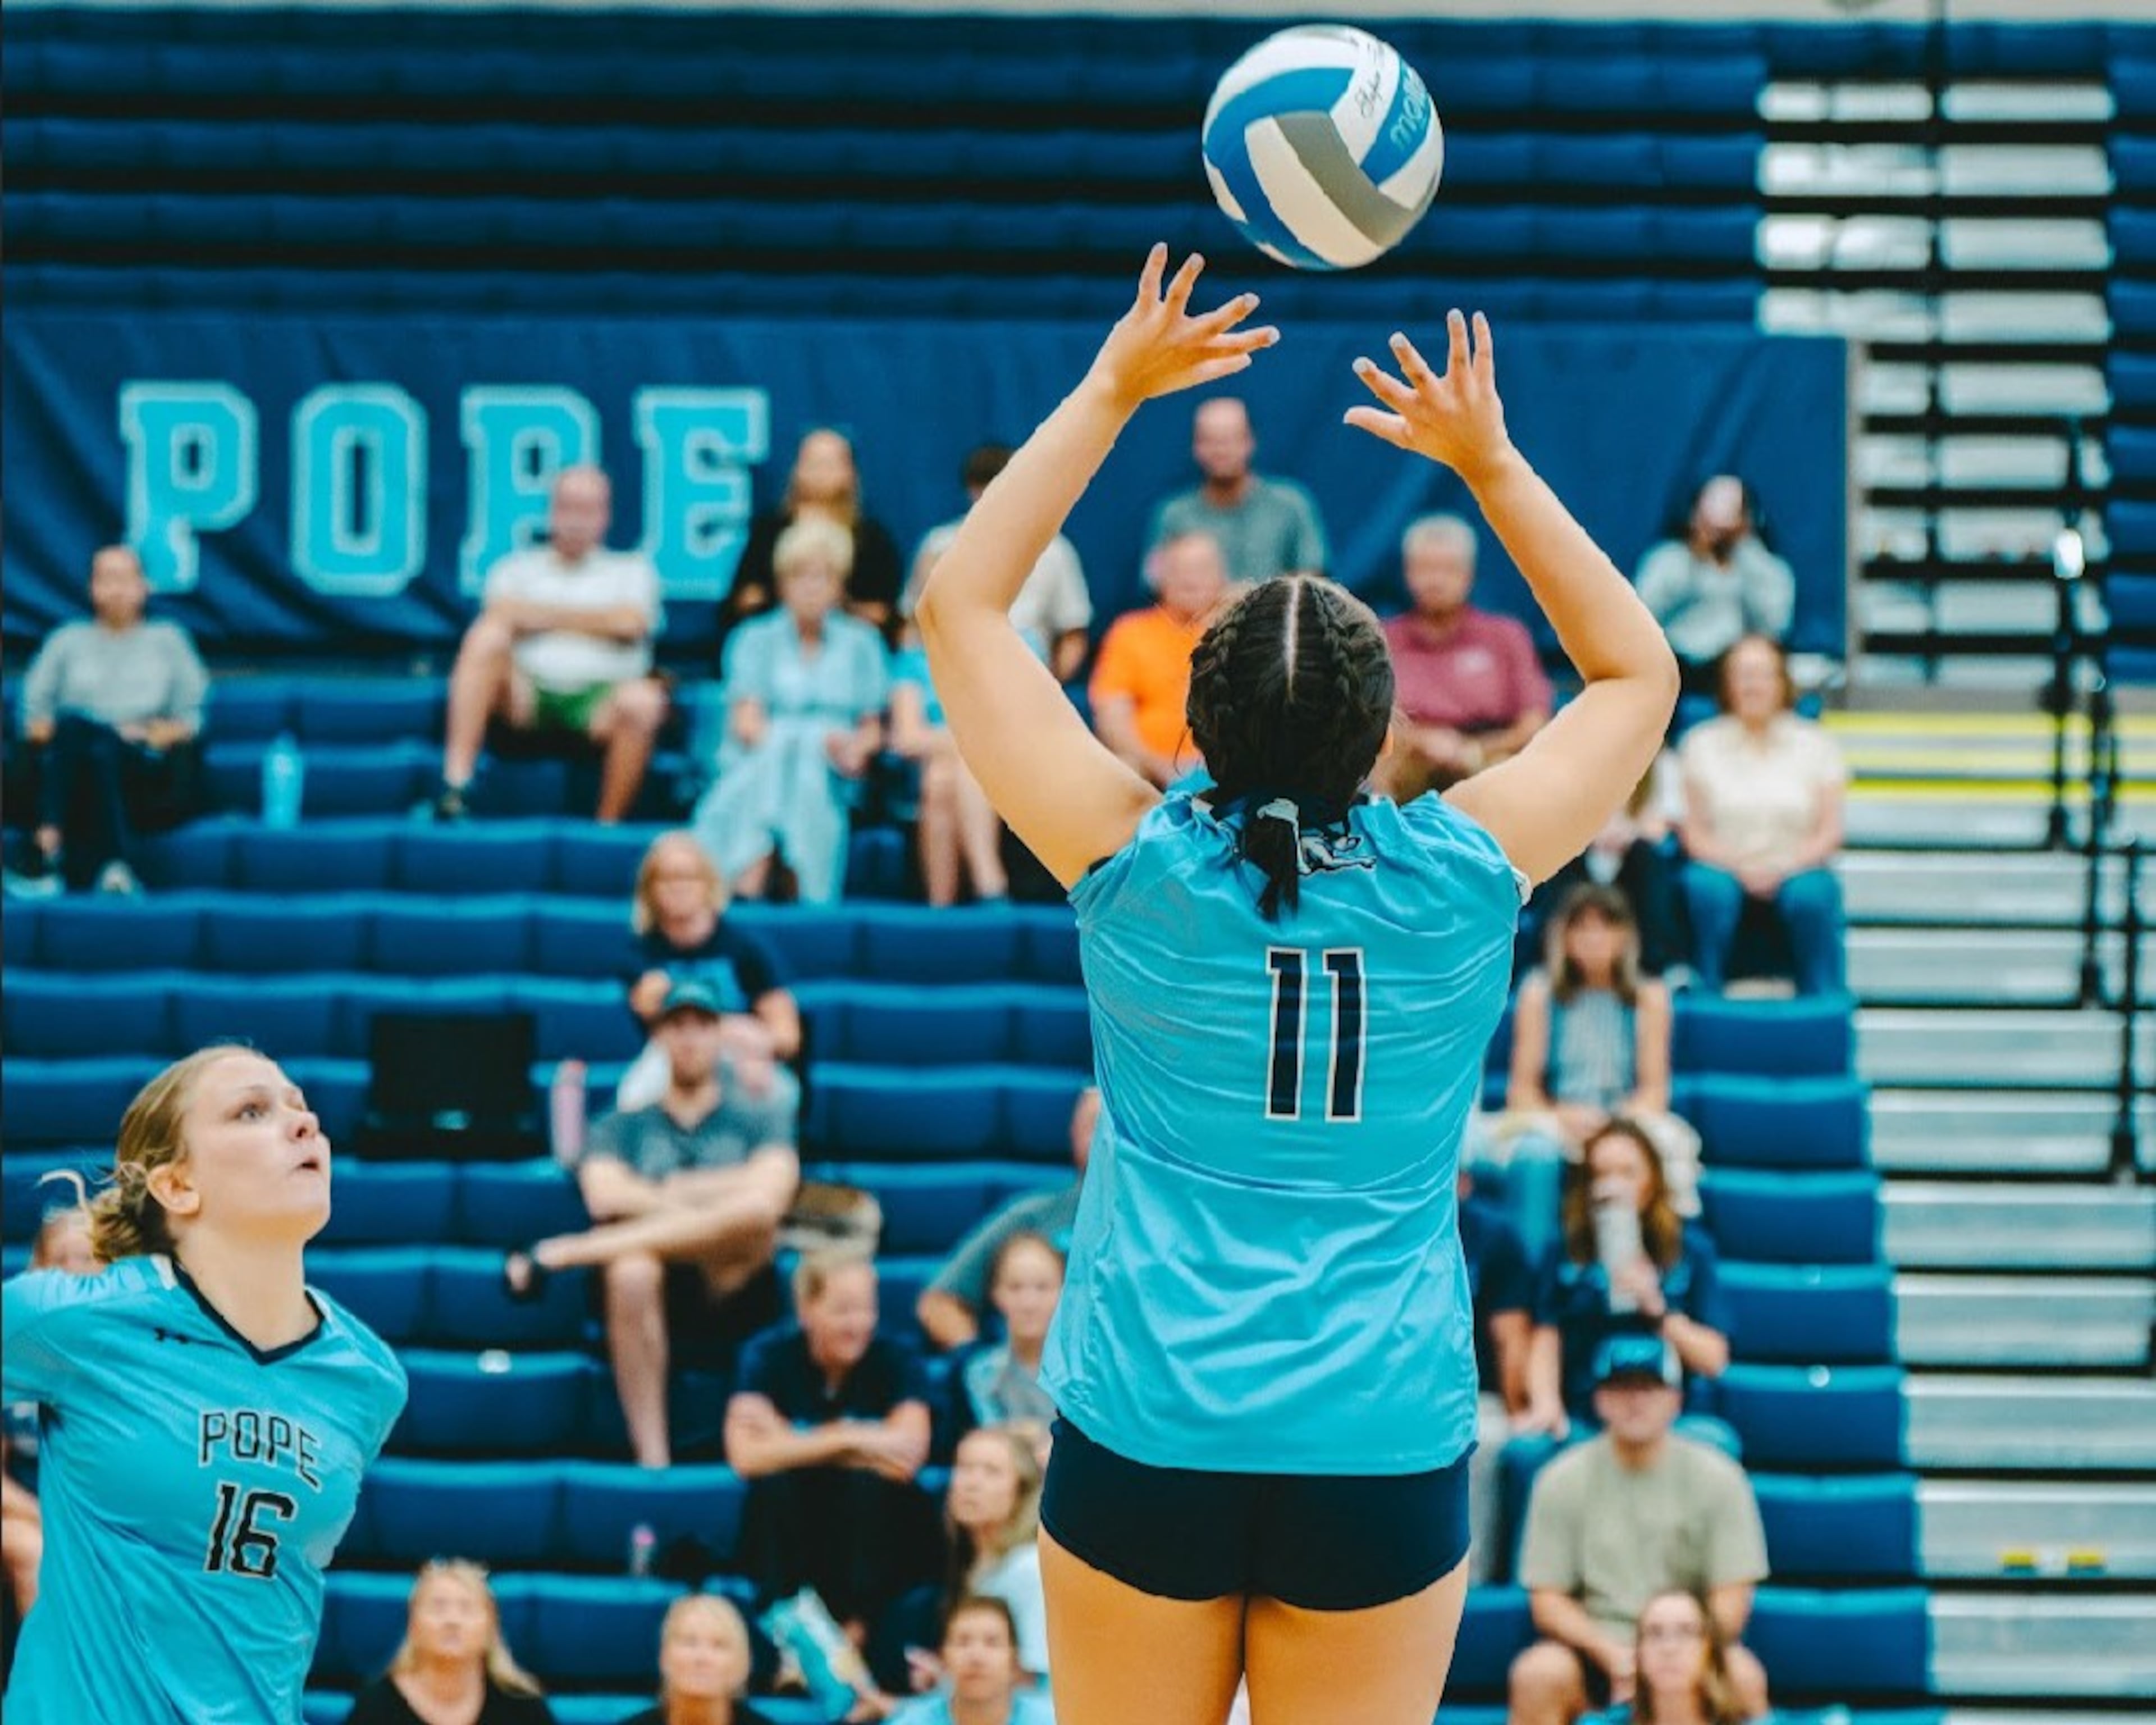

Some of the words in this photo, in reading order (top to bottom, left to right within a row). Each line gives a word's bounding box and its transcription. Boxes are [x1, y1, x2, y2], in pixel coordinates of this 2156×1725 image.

[120, 381, 769, 600] POPE
[1265, 946, 1367, 1122] 11
[199, 1408, 323, 1494] POPE
[204, 1479, 299, 1581] 16
